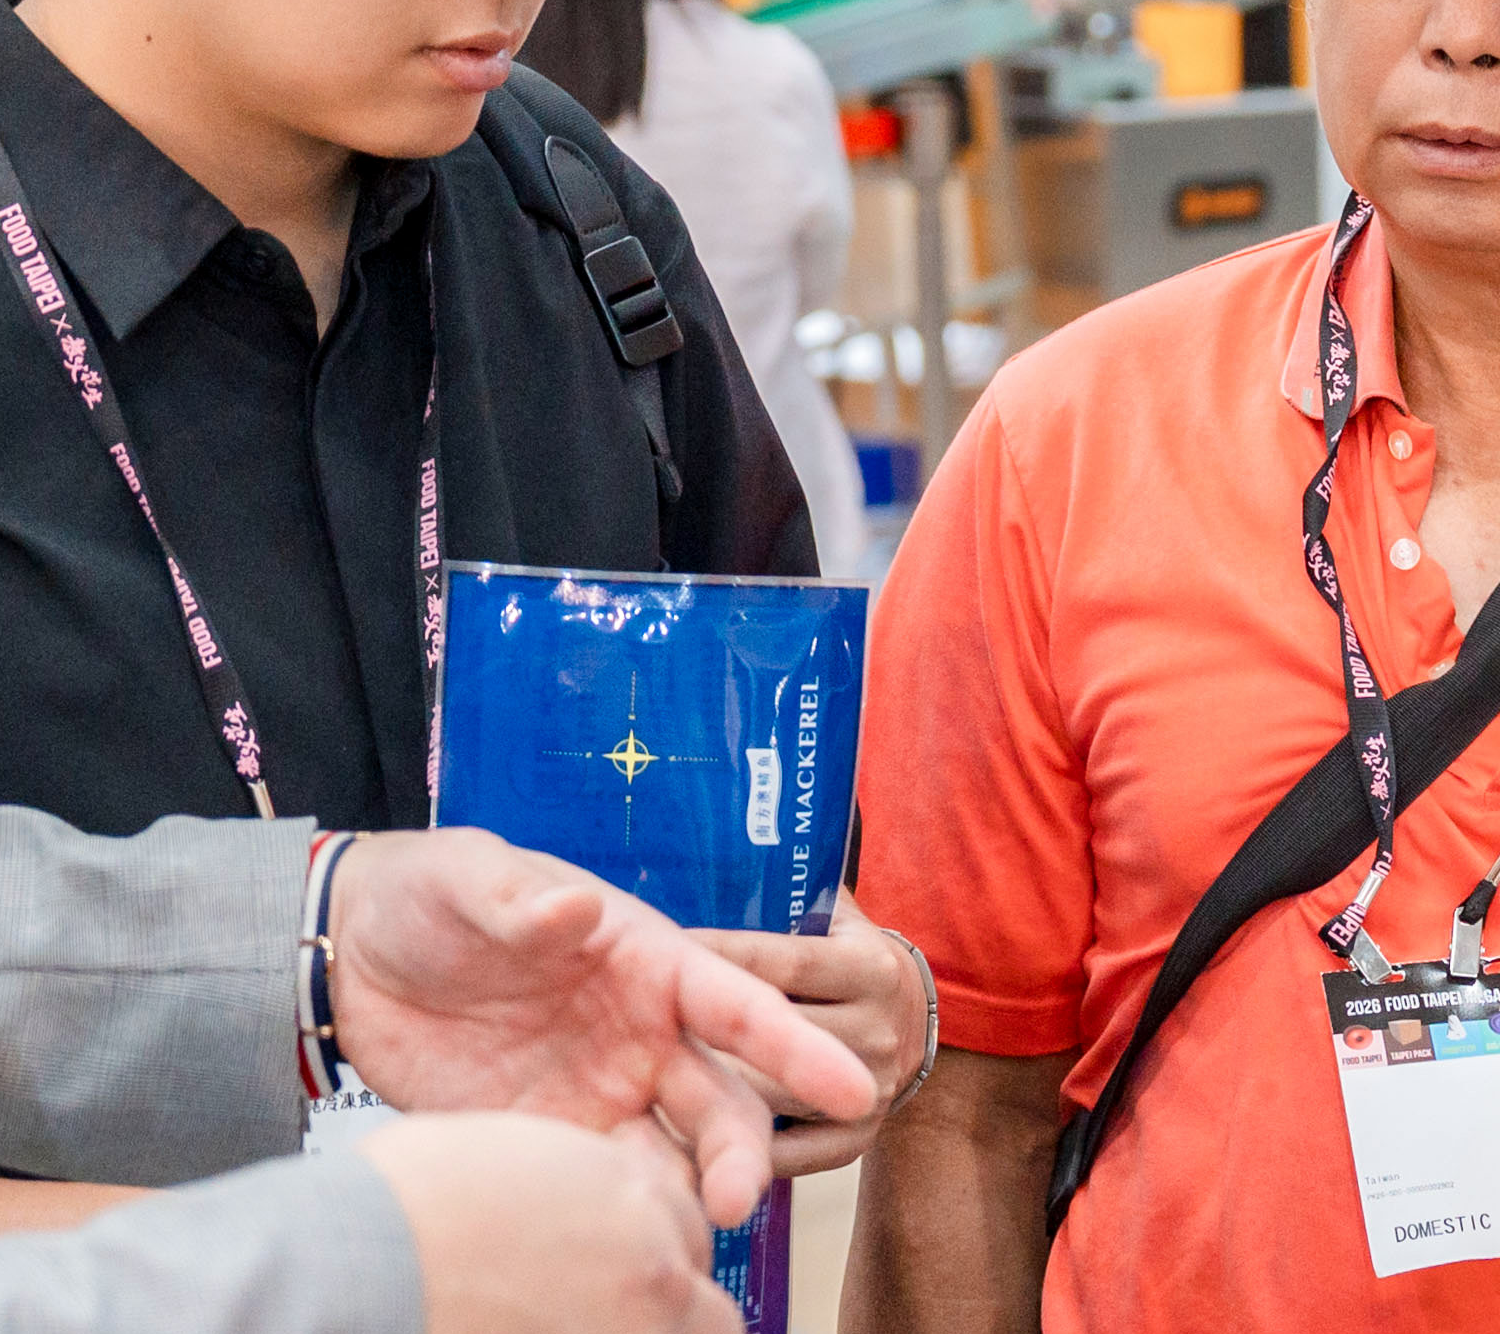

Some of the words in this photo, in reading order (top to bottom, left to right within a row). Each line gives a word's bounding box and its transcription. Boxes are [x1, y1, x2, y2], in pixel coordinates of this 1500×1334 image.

[20, 251, 66, 314] TAIPEI
[109, 442, 141, 494] FOOD
[421, 458, 437, 510] FOOD
[1314, 459, 1338, 503] FOO
[420, 510, 440, 570] TAIPEI
[188, 616, 223, 669] FOOD
[1351, 655, 1377, 699] FOOD
[794, 675, 820, 834] MACKEREL
[789, 844, 813, 919] BLUE
[1328, 903, 1366, 948] AIPEI
[1345, 996, 1382, 1017] 2026
[1385, 992, 1420, 1012] FOOD
[1420, 988, 1464, 1009] TAIPEI
[1341, 1055, 1360, 1066] FOOD
[1361, 1053, 1384, 1065] TAIPEI
[1390, 1050, 1414, 1062] TAIPEI
[1414, 1048, 1433, 1059] PACK
[312, 1088, 385, 1114] 冷凍食
[1394, 1213, 1492, 1244] DOMESTIC
